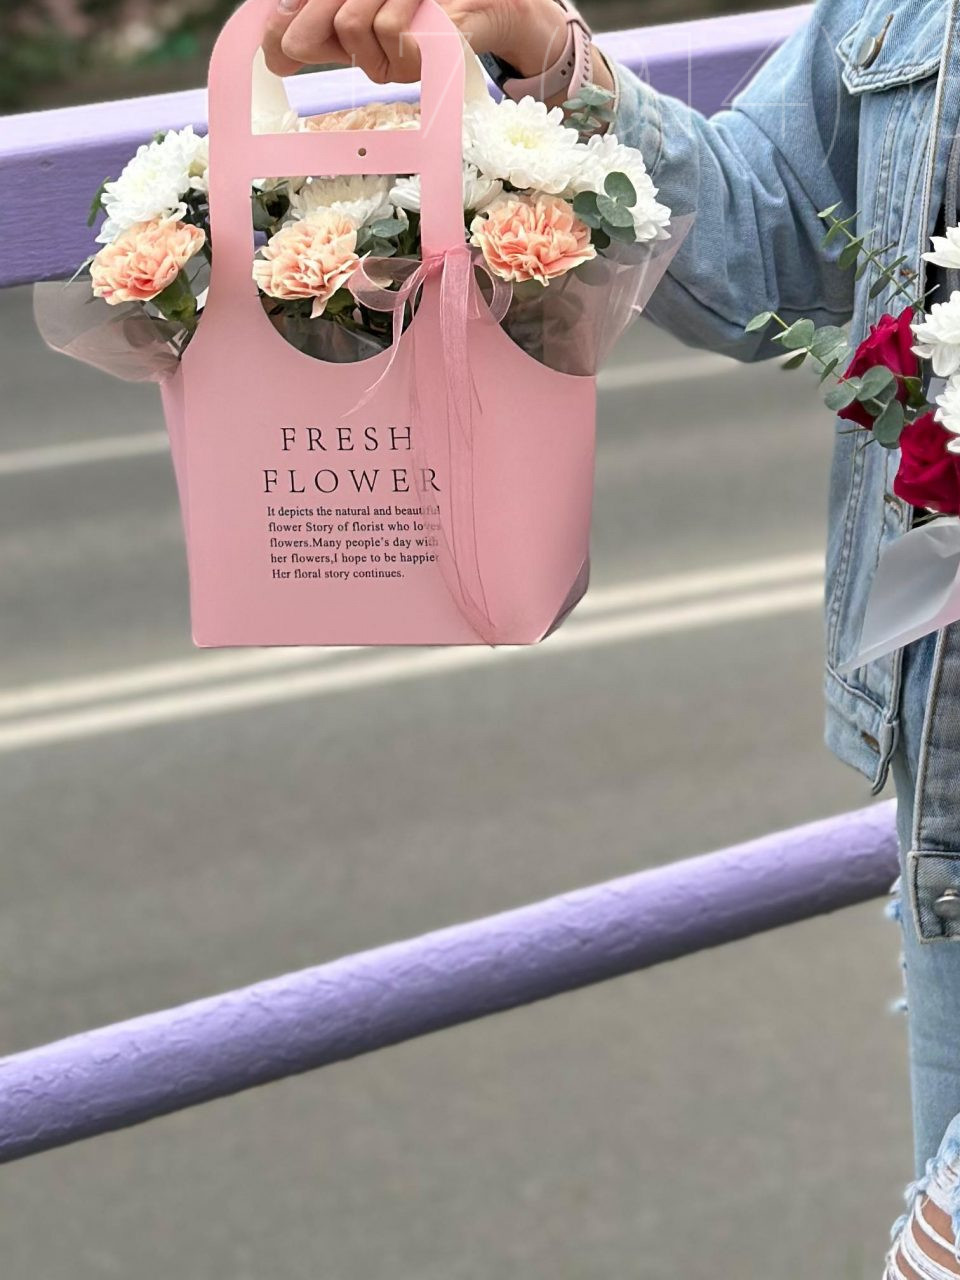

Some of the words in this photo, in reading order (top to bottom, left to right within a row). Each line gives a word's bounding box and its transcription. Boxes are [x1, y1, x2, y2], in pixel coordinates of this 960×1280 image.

[281, 427, 413, 451] FRESH
[264, 469, 441, 493] FLOWER
[268, 507, 276, 516] It
[278, 506, 314, 518] depicts
[317, 506, 333, 516] the
[335, 506, 370, 516] natural
[374, 506, 392, 516] and
[269, 522, 302, 532] flower
[306, 522, 333, 534] Story
[338, 522, 349, 532] of
[353, 522, 384, 531] florist
[388, 522, 410, 531] who
[393, 537, 411, 548] day
[271, 554, 287, 563] her
[342, 554, 367, 564] hope
[384, 553, 397, 562] be
[273, 570, 290, 579] Her
[294, 569, 321, 578] floral
[325, 570, 350, 580] story
[353, 569, 404, 578] continues.
